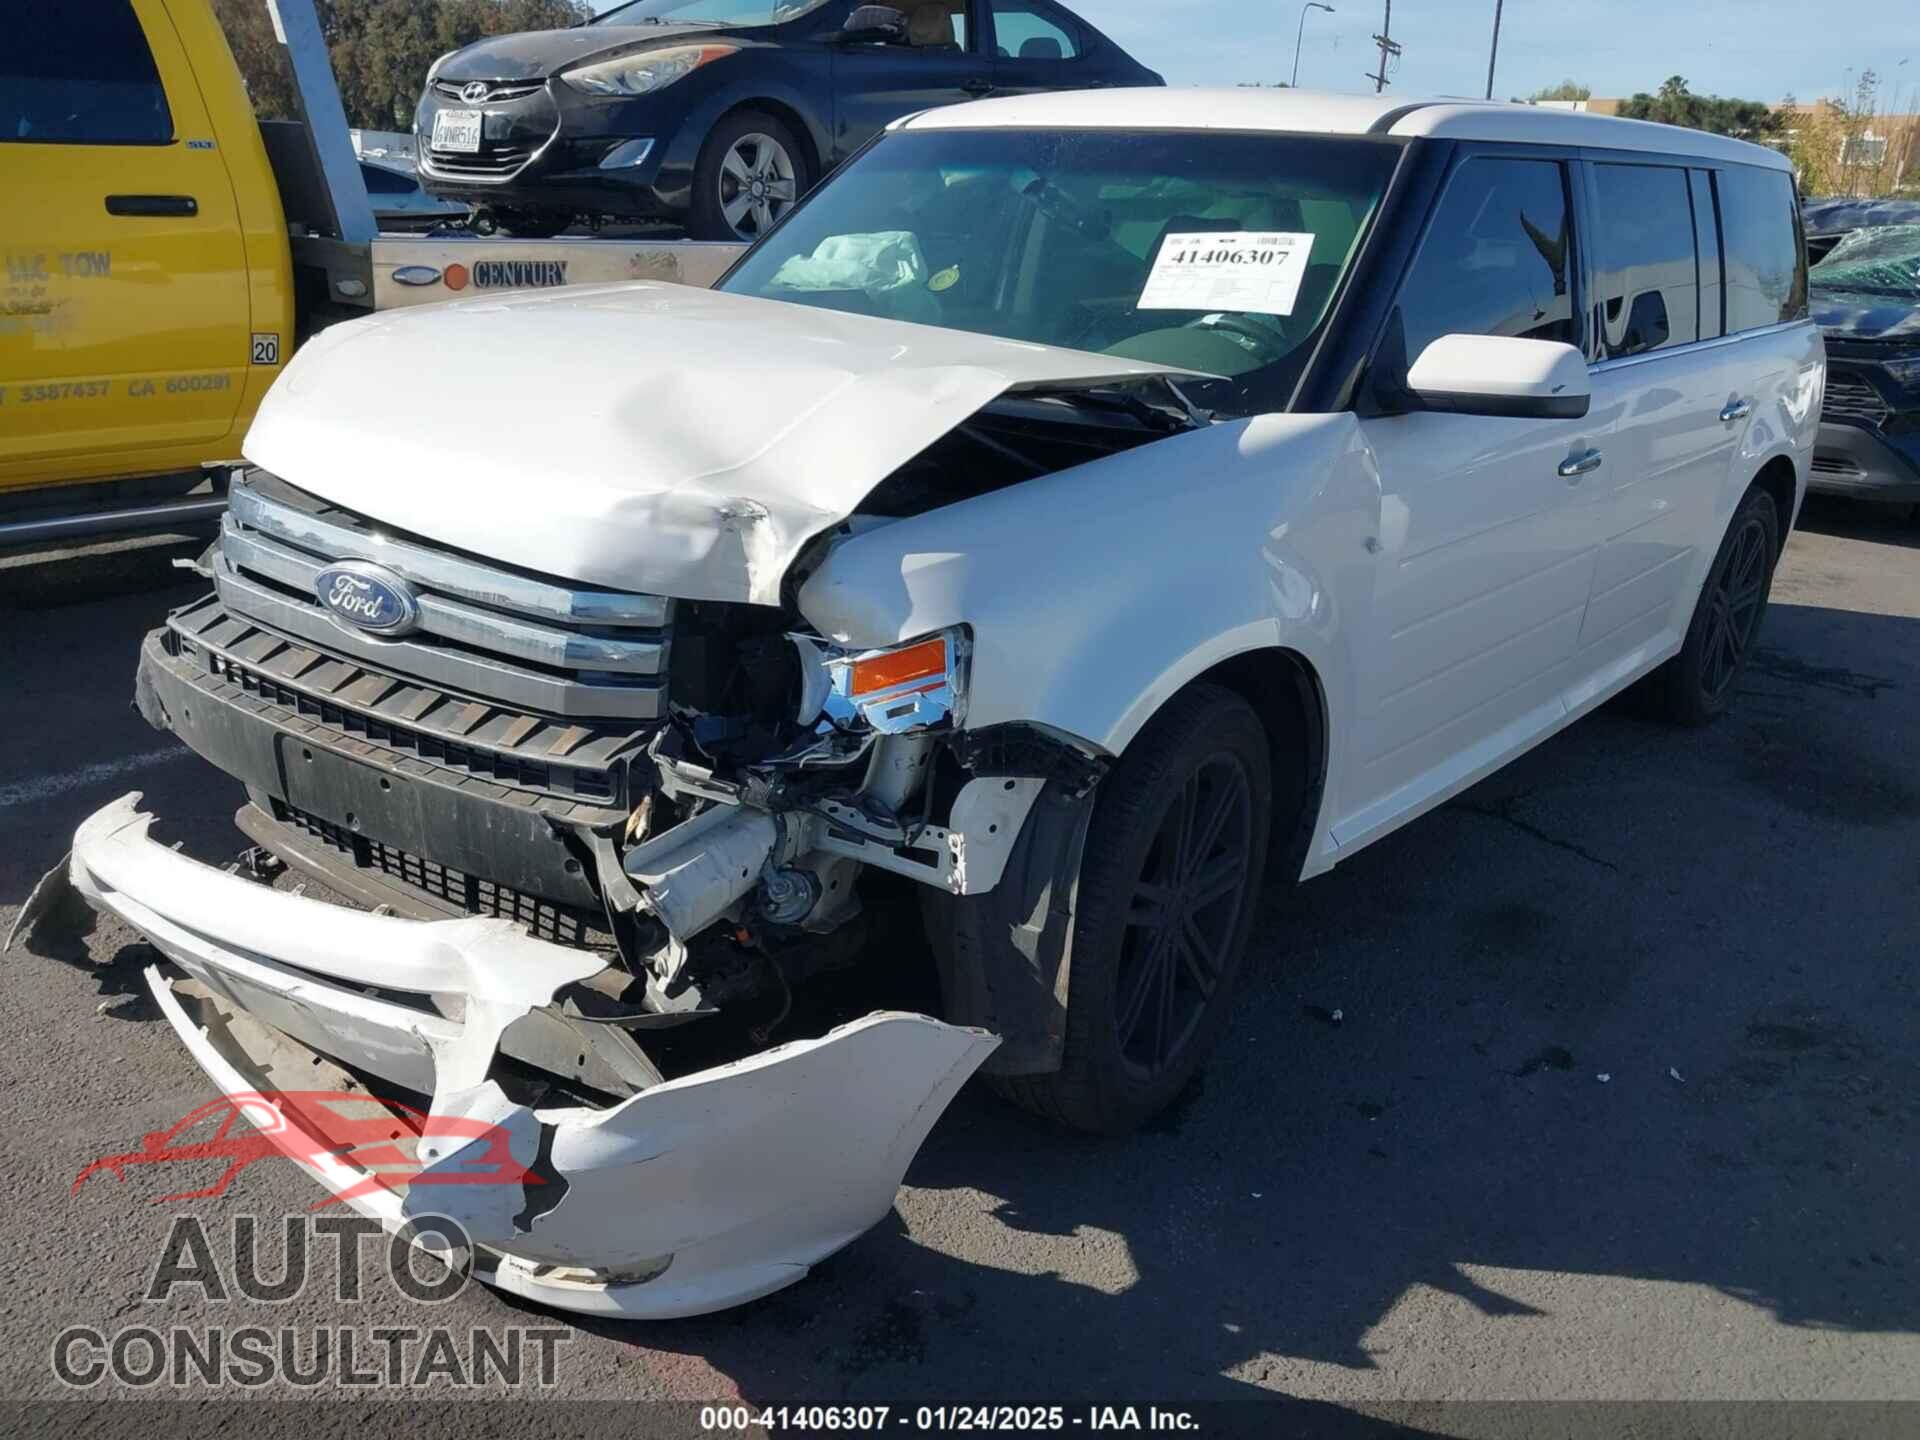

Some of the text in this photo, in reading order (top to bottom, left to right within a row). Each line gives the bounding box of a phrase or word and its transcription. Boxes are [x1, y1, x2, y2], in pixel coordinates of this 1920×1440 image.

[59, 252, 111, 277] TOW
[1171, 249, 1290, 265] 41406307
[473, 260, 568, 286] CENTURY
[255, 342, 276, 361] 20
[128, 380, 156, 397] CA
[329, 575, 383, 618] Ford
